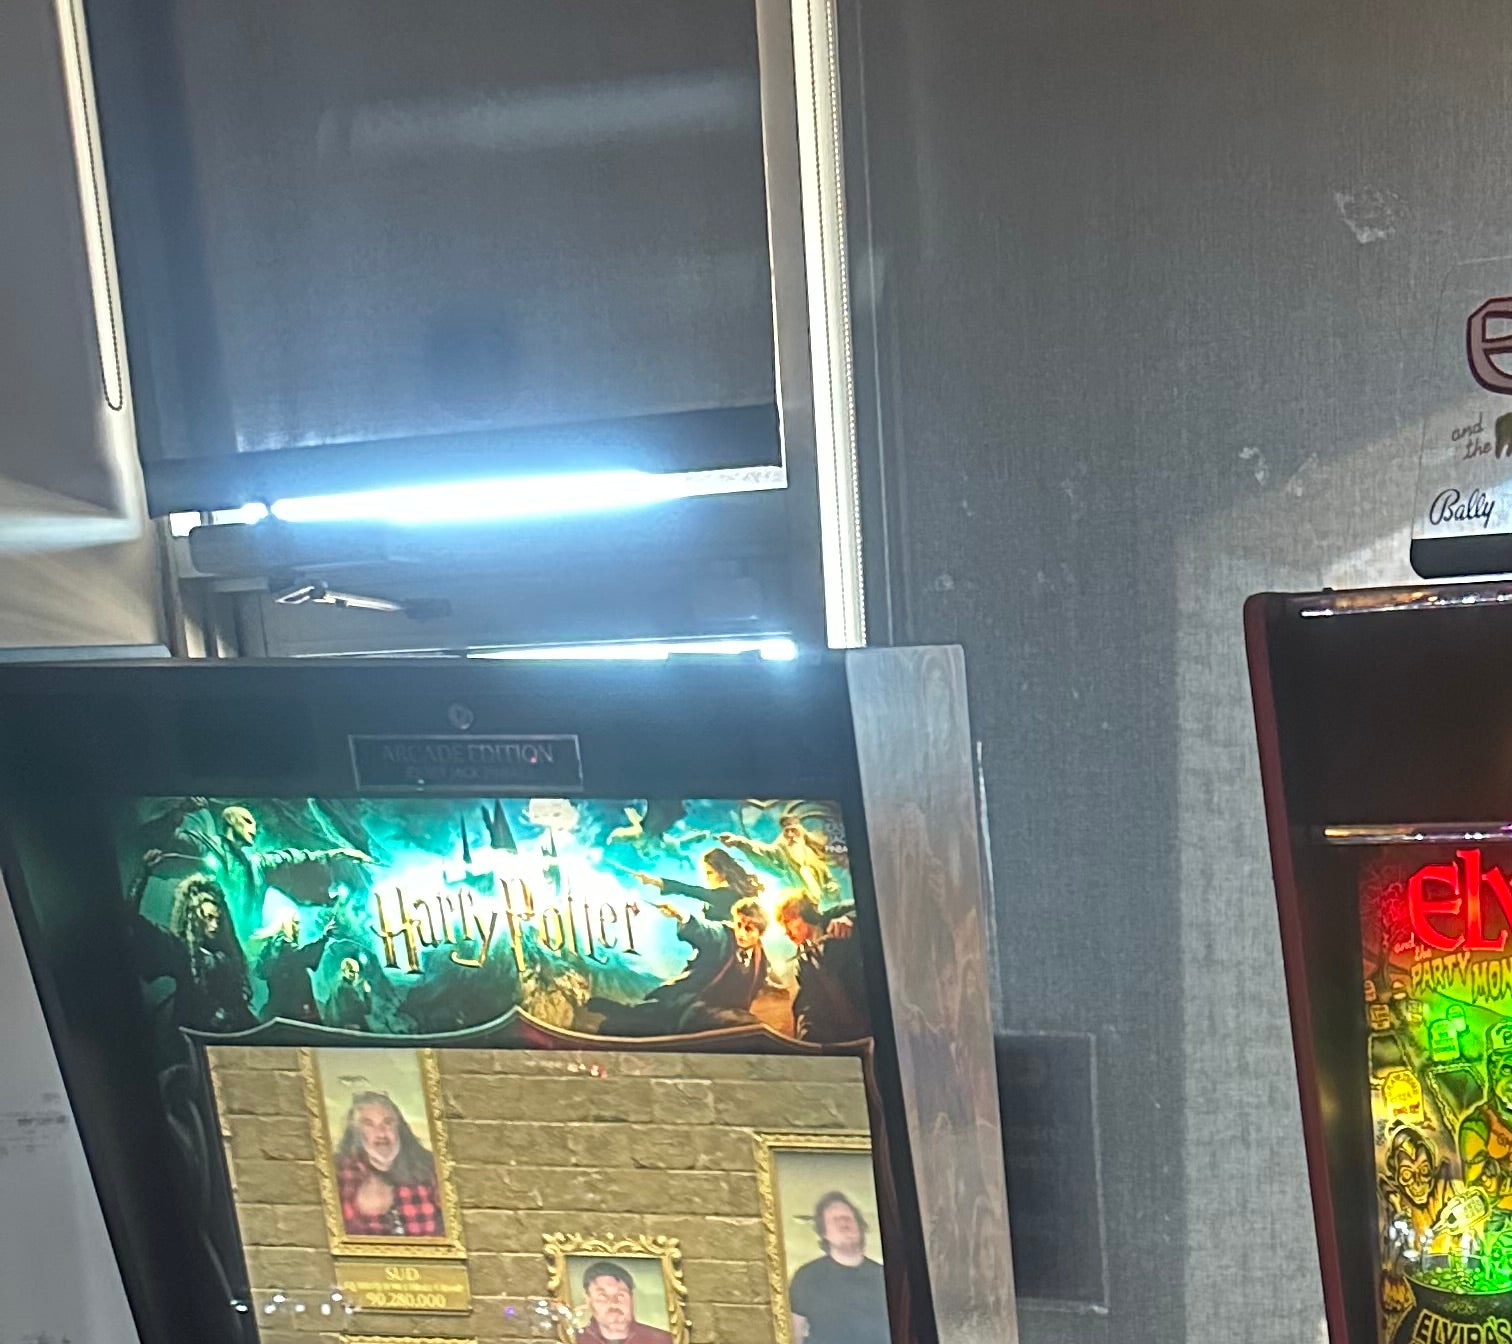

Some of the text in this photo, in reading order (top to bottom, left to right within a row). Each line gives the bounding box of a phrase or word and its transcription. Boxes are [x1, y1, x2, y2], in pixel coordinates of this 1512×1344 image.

[1451, 411, 1485, 442] and
[1462, 436, 1492, 461] the
[1428, 487, 1496, 529] Bally
[466, 743, 555, 764] EDITION
[369, 877, 642, 975] Harry Potter
[1410, 951, 1472, 998] PARTY
[384, 1266, 421, 1282] SUD
